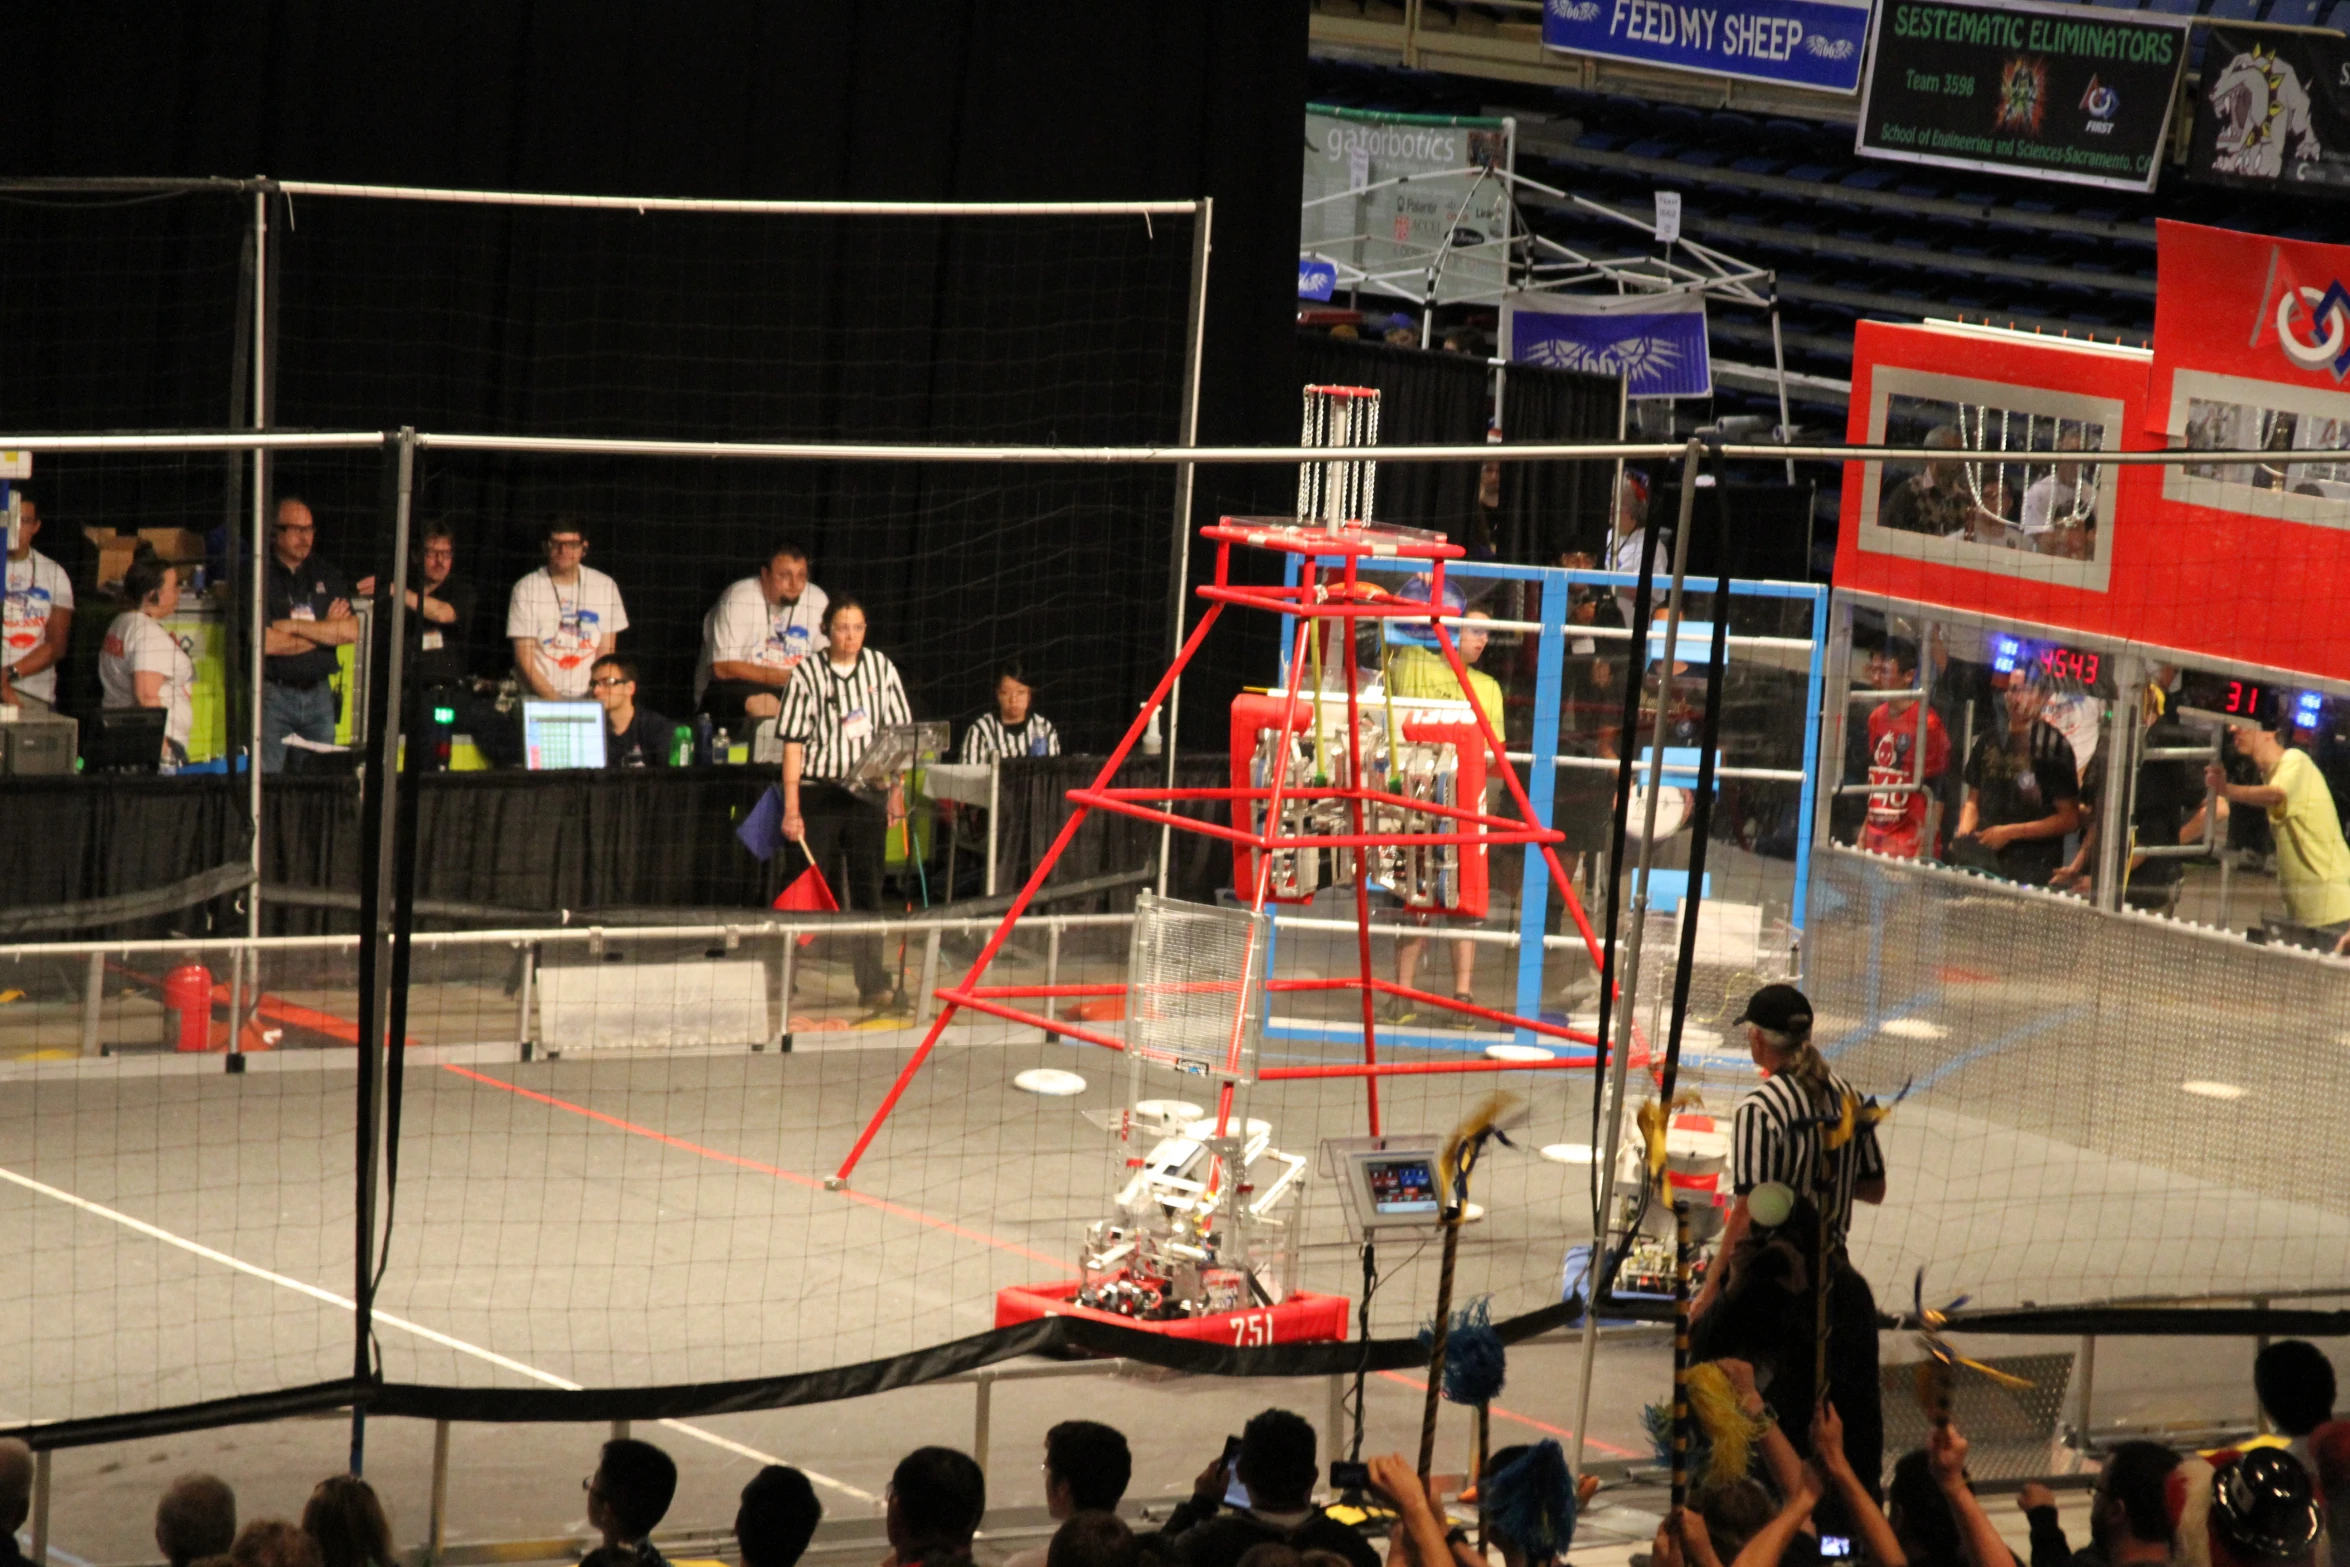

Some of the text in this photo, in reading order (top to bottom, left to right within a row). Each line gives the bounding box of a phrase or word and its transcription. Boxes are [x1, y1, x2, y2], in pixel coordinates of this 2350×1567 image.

[1610, 0, 1803, 61] FEED MY SHEEP
[1894, 5, 2173, 65] SESTEMATIC ELIMINATORS
[1906, 68, 1976, 96] Team 3598
[1881, 122, 1917, 144] School
[1918, 127, 1931, 145] of
[1932, 129, 1993, 156] Engineering
[1996, 138, 2015, 155] and
[2085, 120, 2115, 134] FIRST
[1328, 127, 1455, 162] gatorbotics
[2041, 648, 2098, 684] 4543
[2225, 681, 2259, 715] 31
[1229, 1313, 1273, 1347] 751
